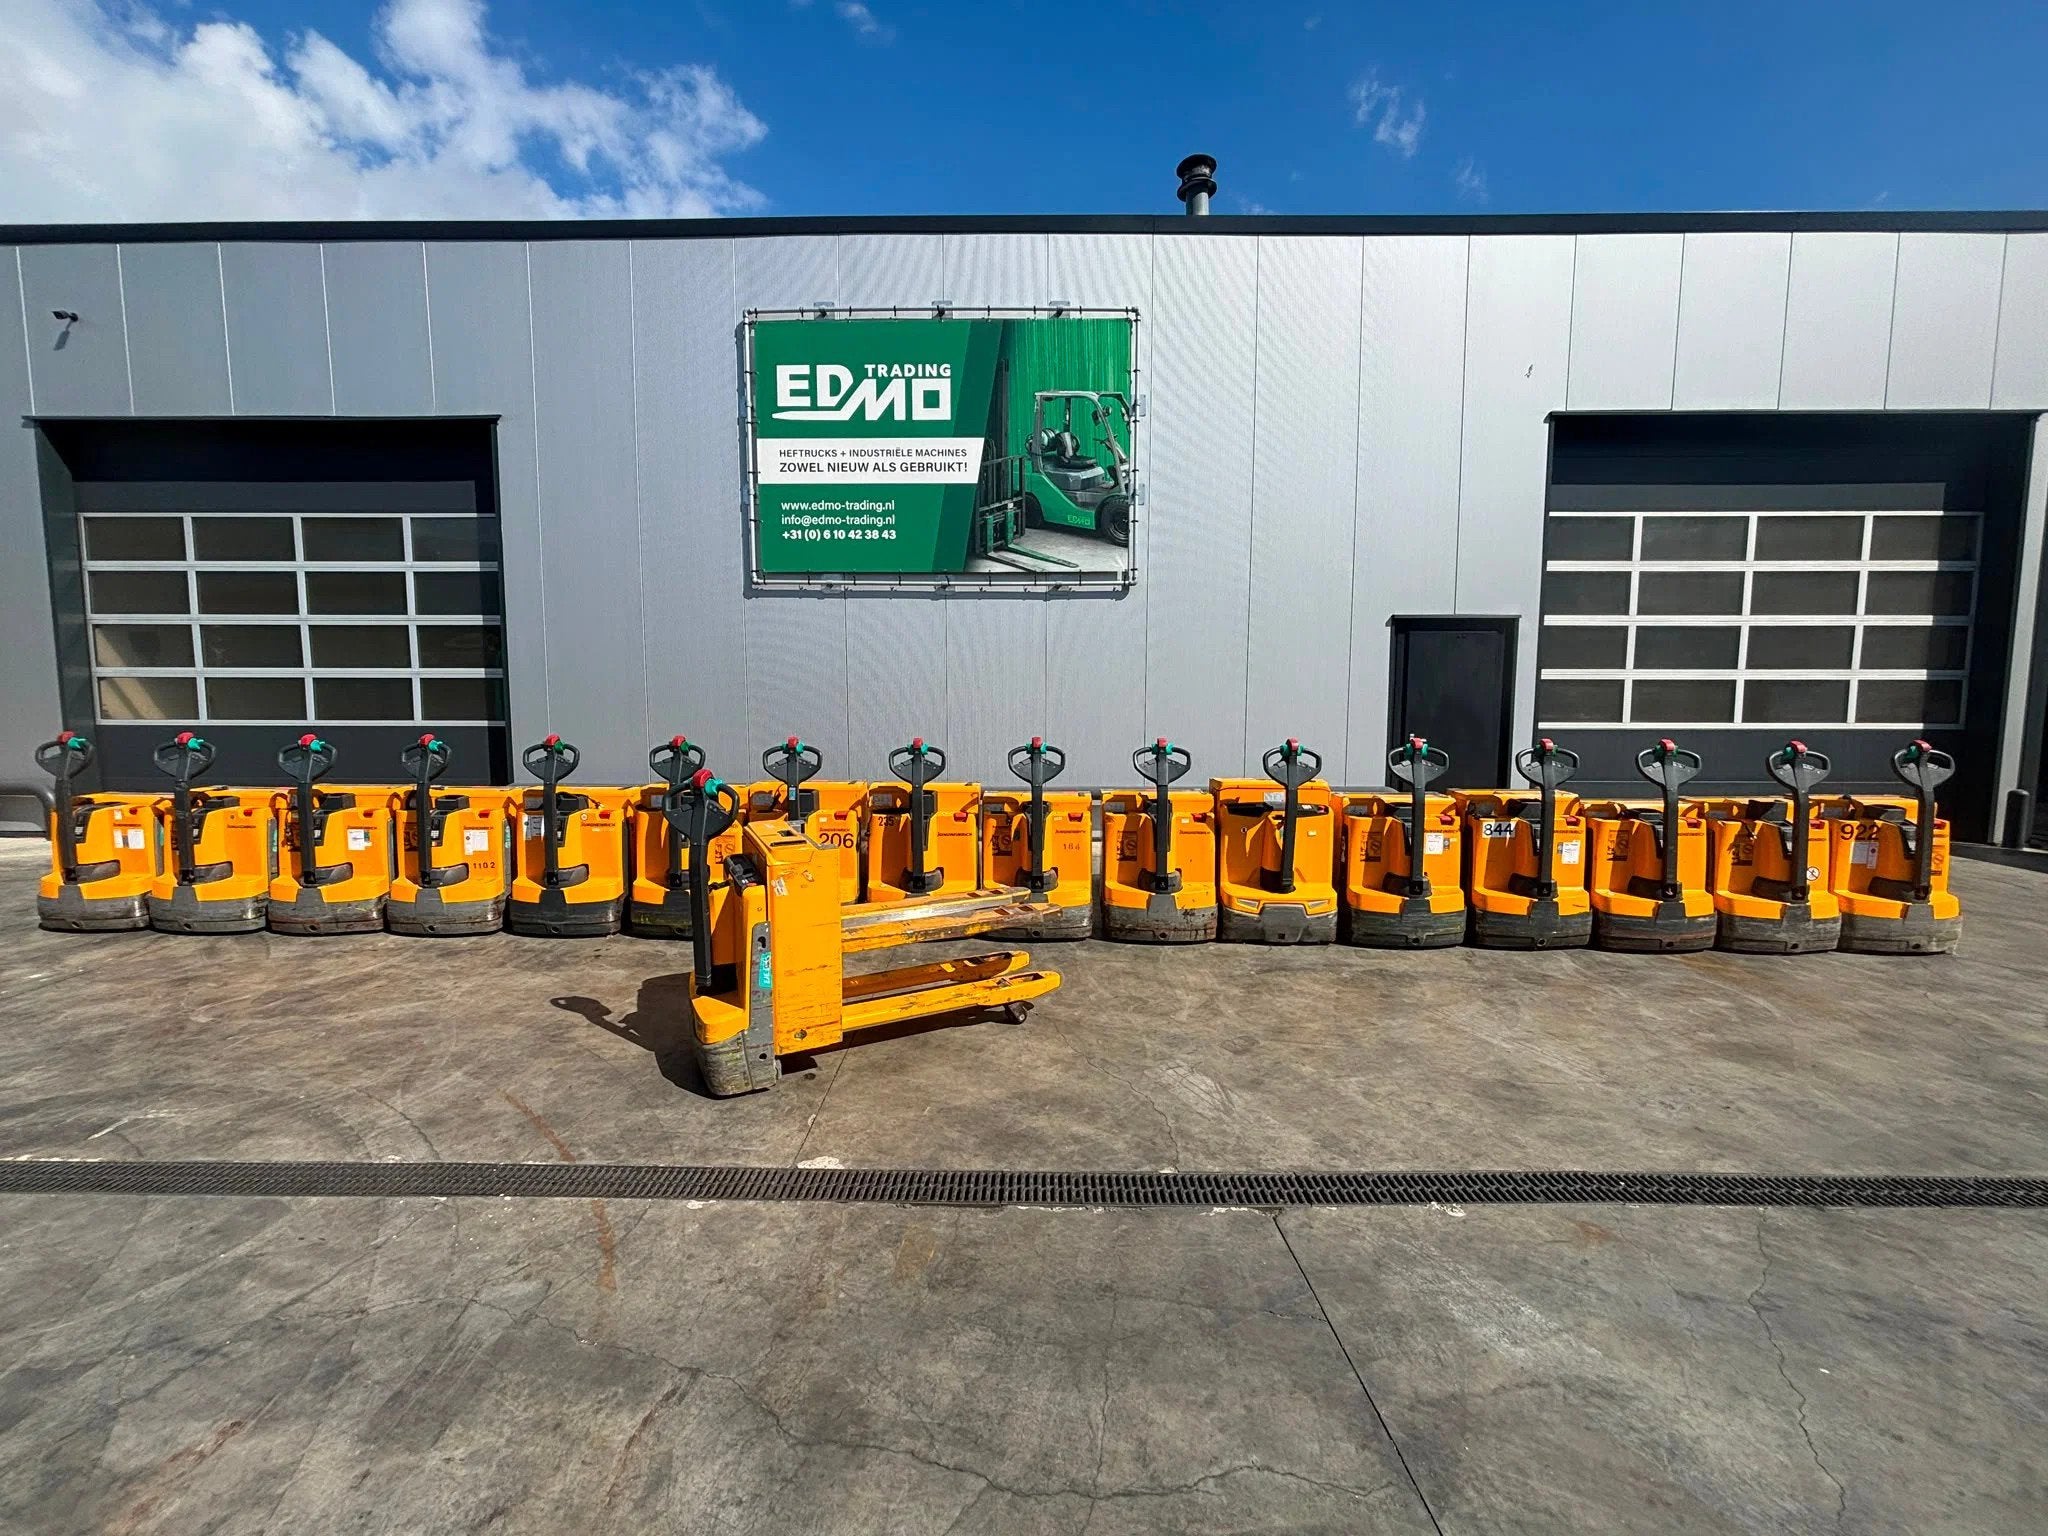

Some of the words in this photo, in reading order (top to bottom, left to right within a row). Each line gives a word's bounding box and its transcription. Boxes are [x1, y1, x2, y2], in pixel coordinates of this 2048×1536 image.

[864, 364, 951, 377] TRADING
[772, 365, 951, 421] EDMO
[779, 449, 838, 458] HEFTRUCKS
[849, 447, 913, 457] INDUSTRIËLE
[915, 448, 967, 457] MACHINES
[779, 462, 824, 473] ZOWEL
[827, 462, 870, 473] NIEUW
[872, 462, 897, 472] ALS
[900, 462, 968, 473] GEBRUIKT!
[781, 500, 895, 513] www.edmo-trading.nl
[781, 515, 896, 528] info@edmo-trading.nl
[1067, 514, 1091, 526] EDMO
[782, 529, 802, 540] +31
[804, 529, 821, 541] (0)
[823, 529, 830, 539] 6
[833, 529, 846, 539] 10
[847, 529, 863, 539] 42
[864, 529, 880, 539] 38
[881, 529, 897, 539] 43
[878, 815, 895, 827] 235
[1484, 823, 1513, 836] 844
[1840, 823, 1881, 841] 922
[819, 832, 854, 849] 206
